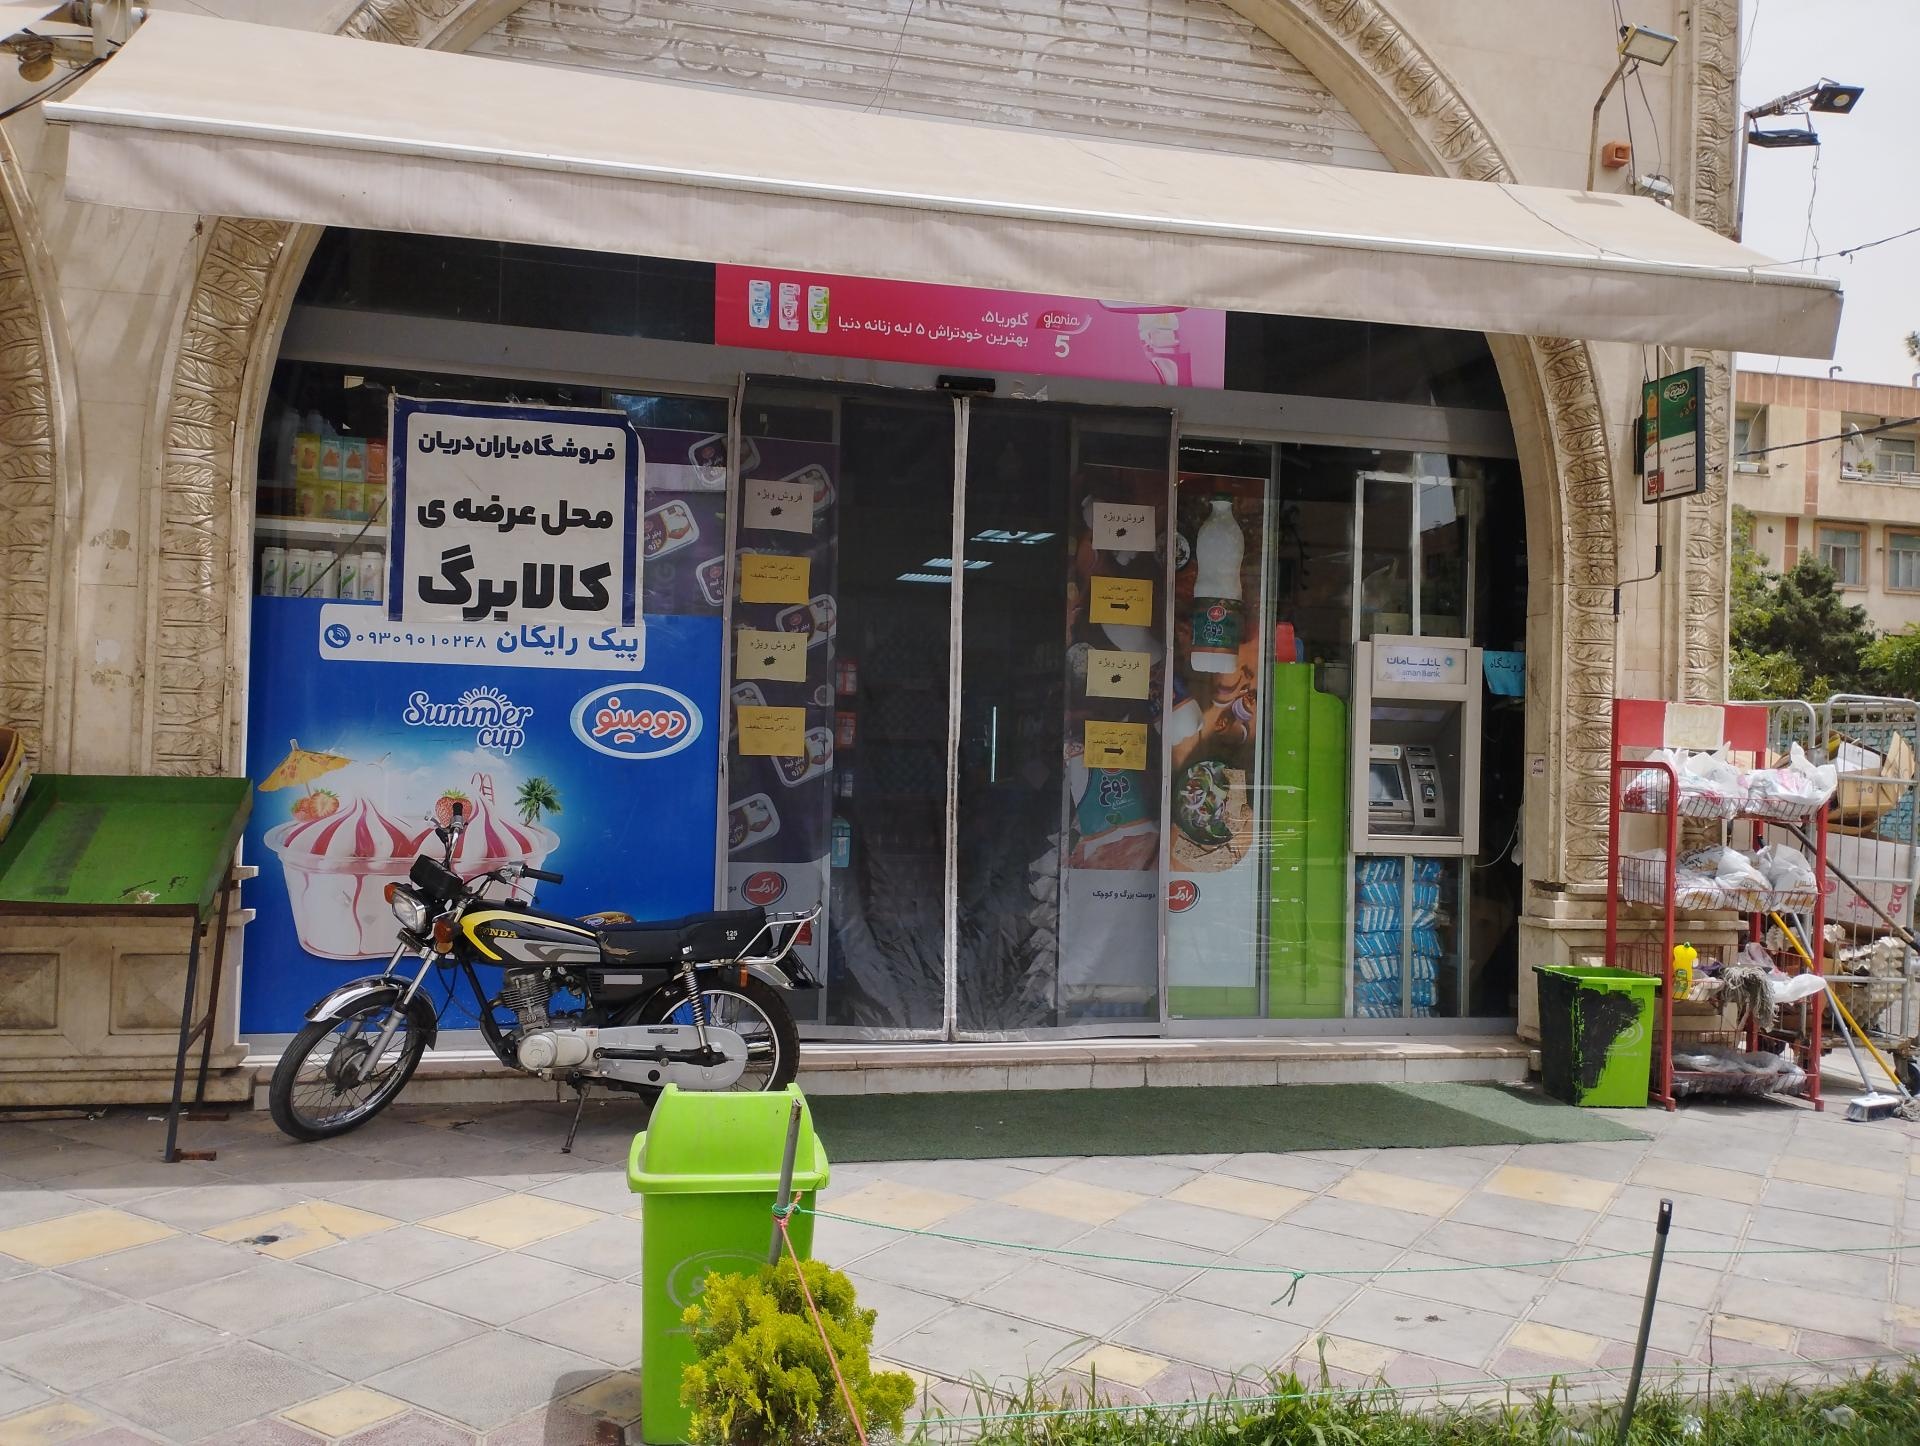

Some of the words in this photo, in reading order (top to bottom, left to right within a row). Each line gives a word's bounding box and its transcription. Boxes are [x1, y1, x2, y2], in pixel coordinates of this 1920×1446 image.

[837, 315, 861, 330] دنیا
[864, 318, 891, 336] زنانه
[894, 320, 912, 336] لبه
[1043, 313, 1081, 328] gloria
[915, 325, 925, 335] ۵
[928, 325, 983, 342] خودتراش
[986, 331, 1029, 348] بهترین
[1054, 335, 1071, 358] 5
[418, 430, 475, 456] دریان
[475, 434, 521, 460] یاران
[521, 433, 616, 465] فروشگاه
[756, 488, 775, 501] ویژه
[777, 491, 803, 503] فروش
[417, 499, 447, 529] ی
[452, 494, 537, 533] عرضه
[541, 499, 614, 536] محل
[1103, 512, 1120, 522] ویژه
[1122, 514, 1145, 524] فروش
[418, 544, 612, 622] کالابرگ
[355, 630, 486, 649] ۰۹۳۰۹۰۱۰۲۴۸
[497, 624, 578, 656] رایگان
[588, 627, 639, 662] پیک
[750, 638, 769, 650] ویژه
[771, 640, 796, 652] فروش
[1098, 657, 1116, 668] ویژه
[1117, 659, 1140, 670] فروش
[1386, 655, 1418, 666] سامان
[1419, 658, 1441, 670] بانک
[1398, 668, 1422, 678] aman
[1422, 669, 1441, 678] Bank
[403, 690, 533, 728] Summer
[591, 696, 687, 744] دومینو
[476, 727, 526, 757] cup
[1099, 775, 1130, 808] دوغ
[1092, 889, 1113, 900] کوچک
[1119, 889, 1135, 901] بزرگ
[1136, 890, 1156, 900] دوست
